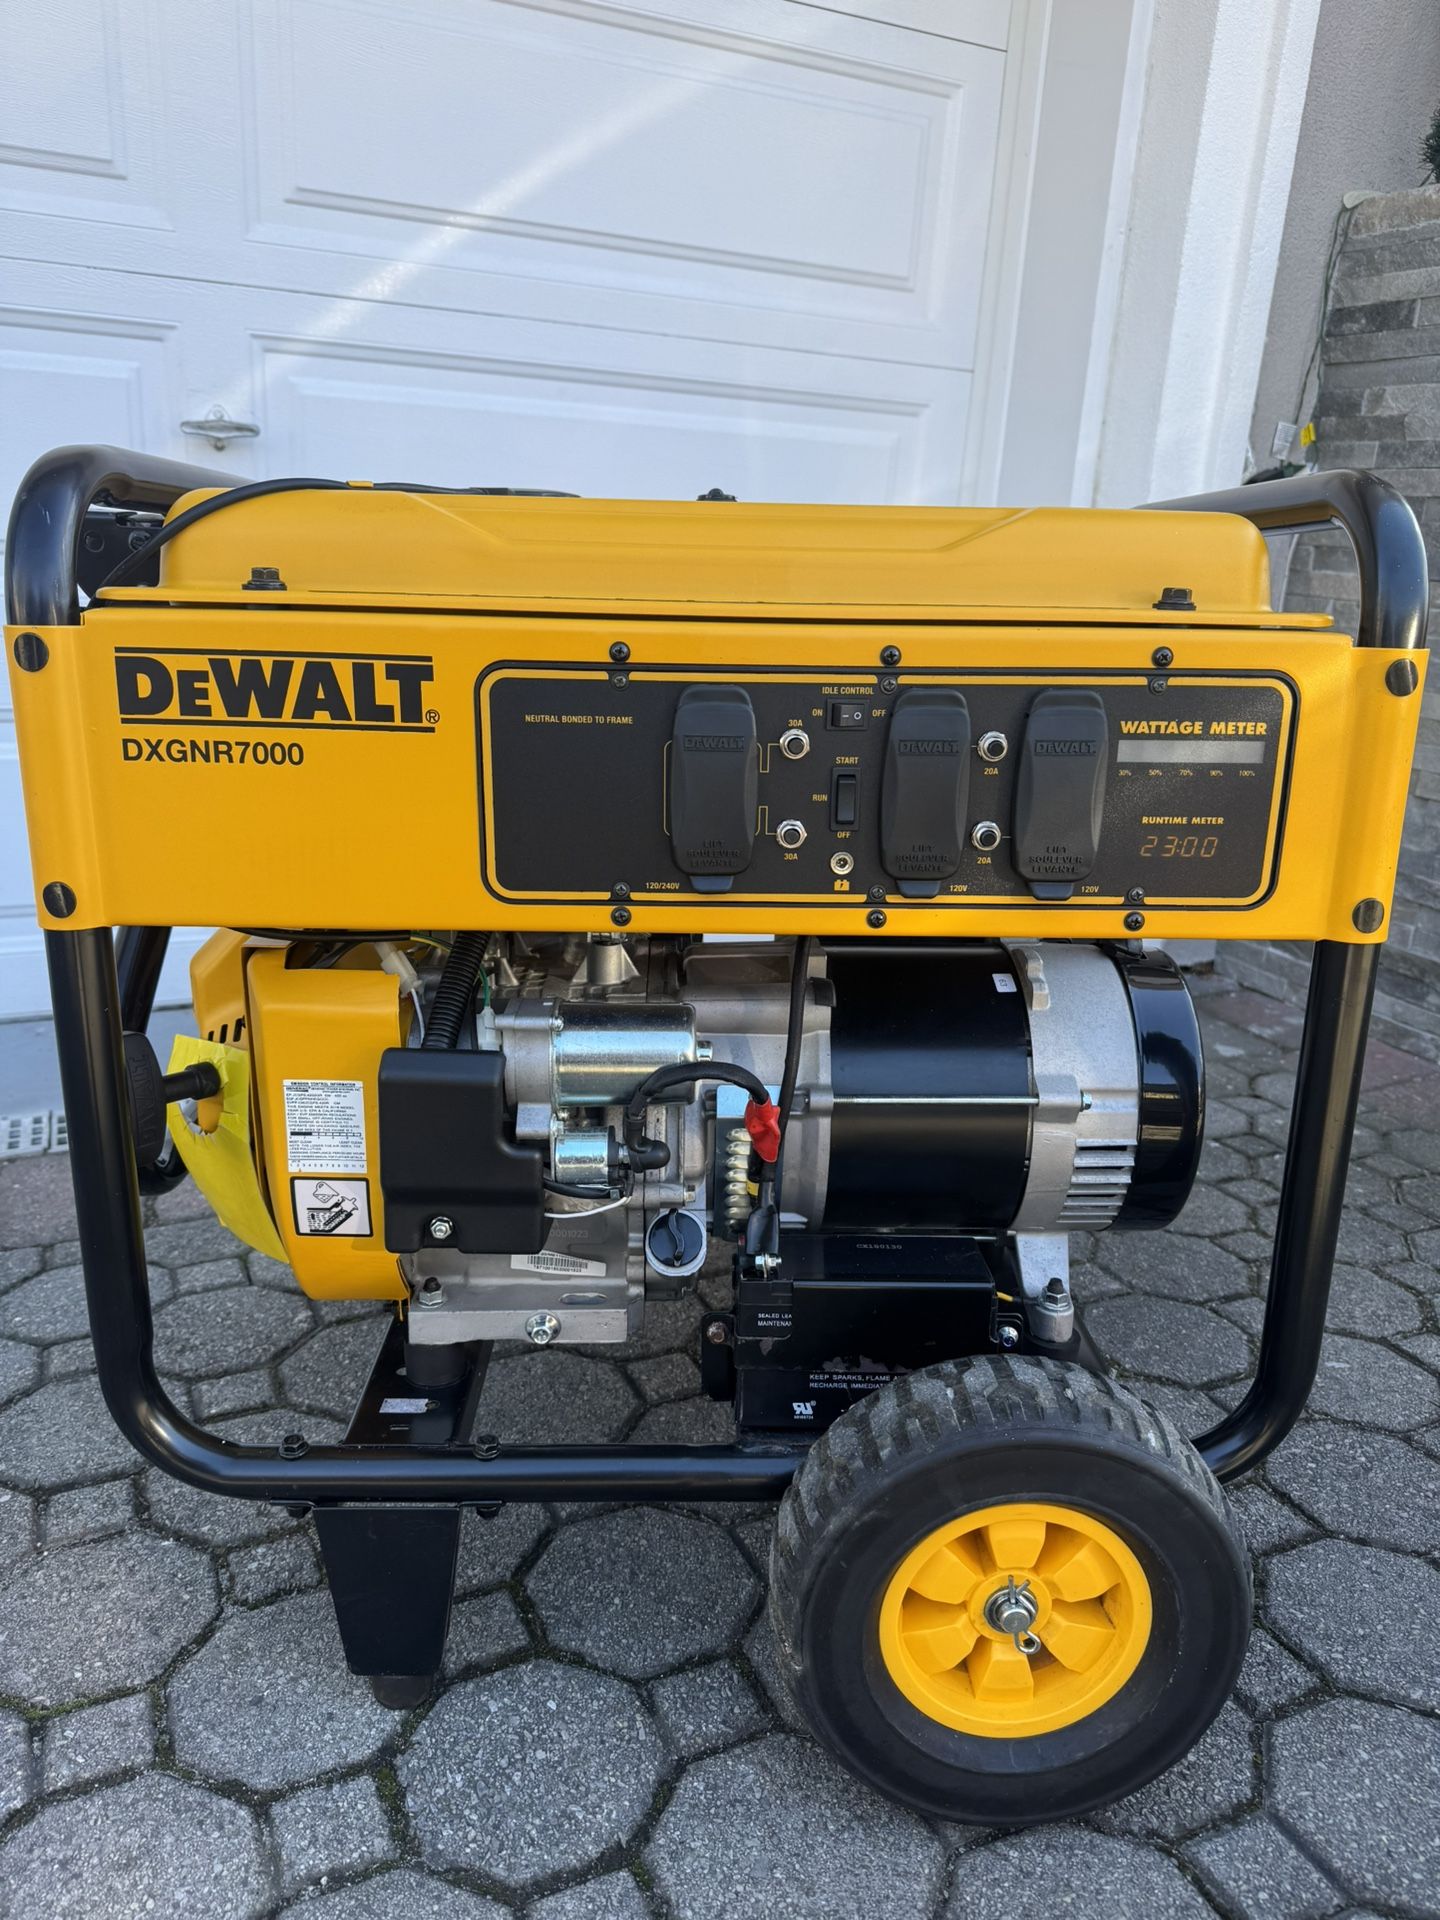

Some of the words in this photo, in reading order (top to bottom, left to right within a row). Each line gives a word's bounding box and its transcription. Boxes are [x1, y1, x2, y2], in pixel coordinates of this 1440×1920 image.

[114, 656, 434, 723] DEWALT
[524, 714, 560, 723] NEUTRAL
[561, 715, 592, 724] BONDED
[594, 716, 604, 724] TO
[606, 716, 633, 724] FRAME
[1120, 720, 1203, 734] WATTAGE
[1209, 722, 1268, 735] METER
[684, 736, 744, 750] DEWALT
[899, 742, 960, 754] DEWALT
[1035, 742, 1096, 754] DEWALT
[122, 738, 304, 765] DXGNR7000
[1142, 816, 1188, 824] RUNTIME
[1191, 816, 1224, 825] METER
[1140, 836, 1218, 858] 23:00
